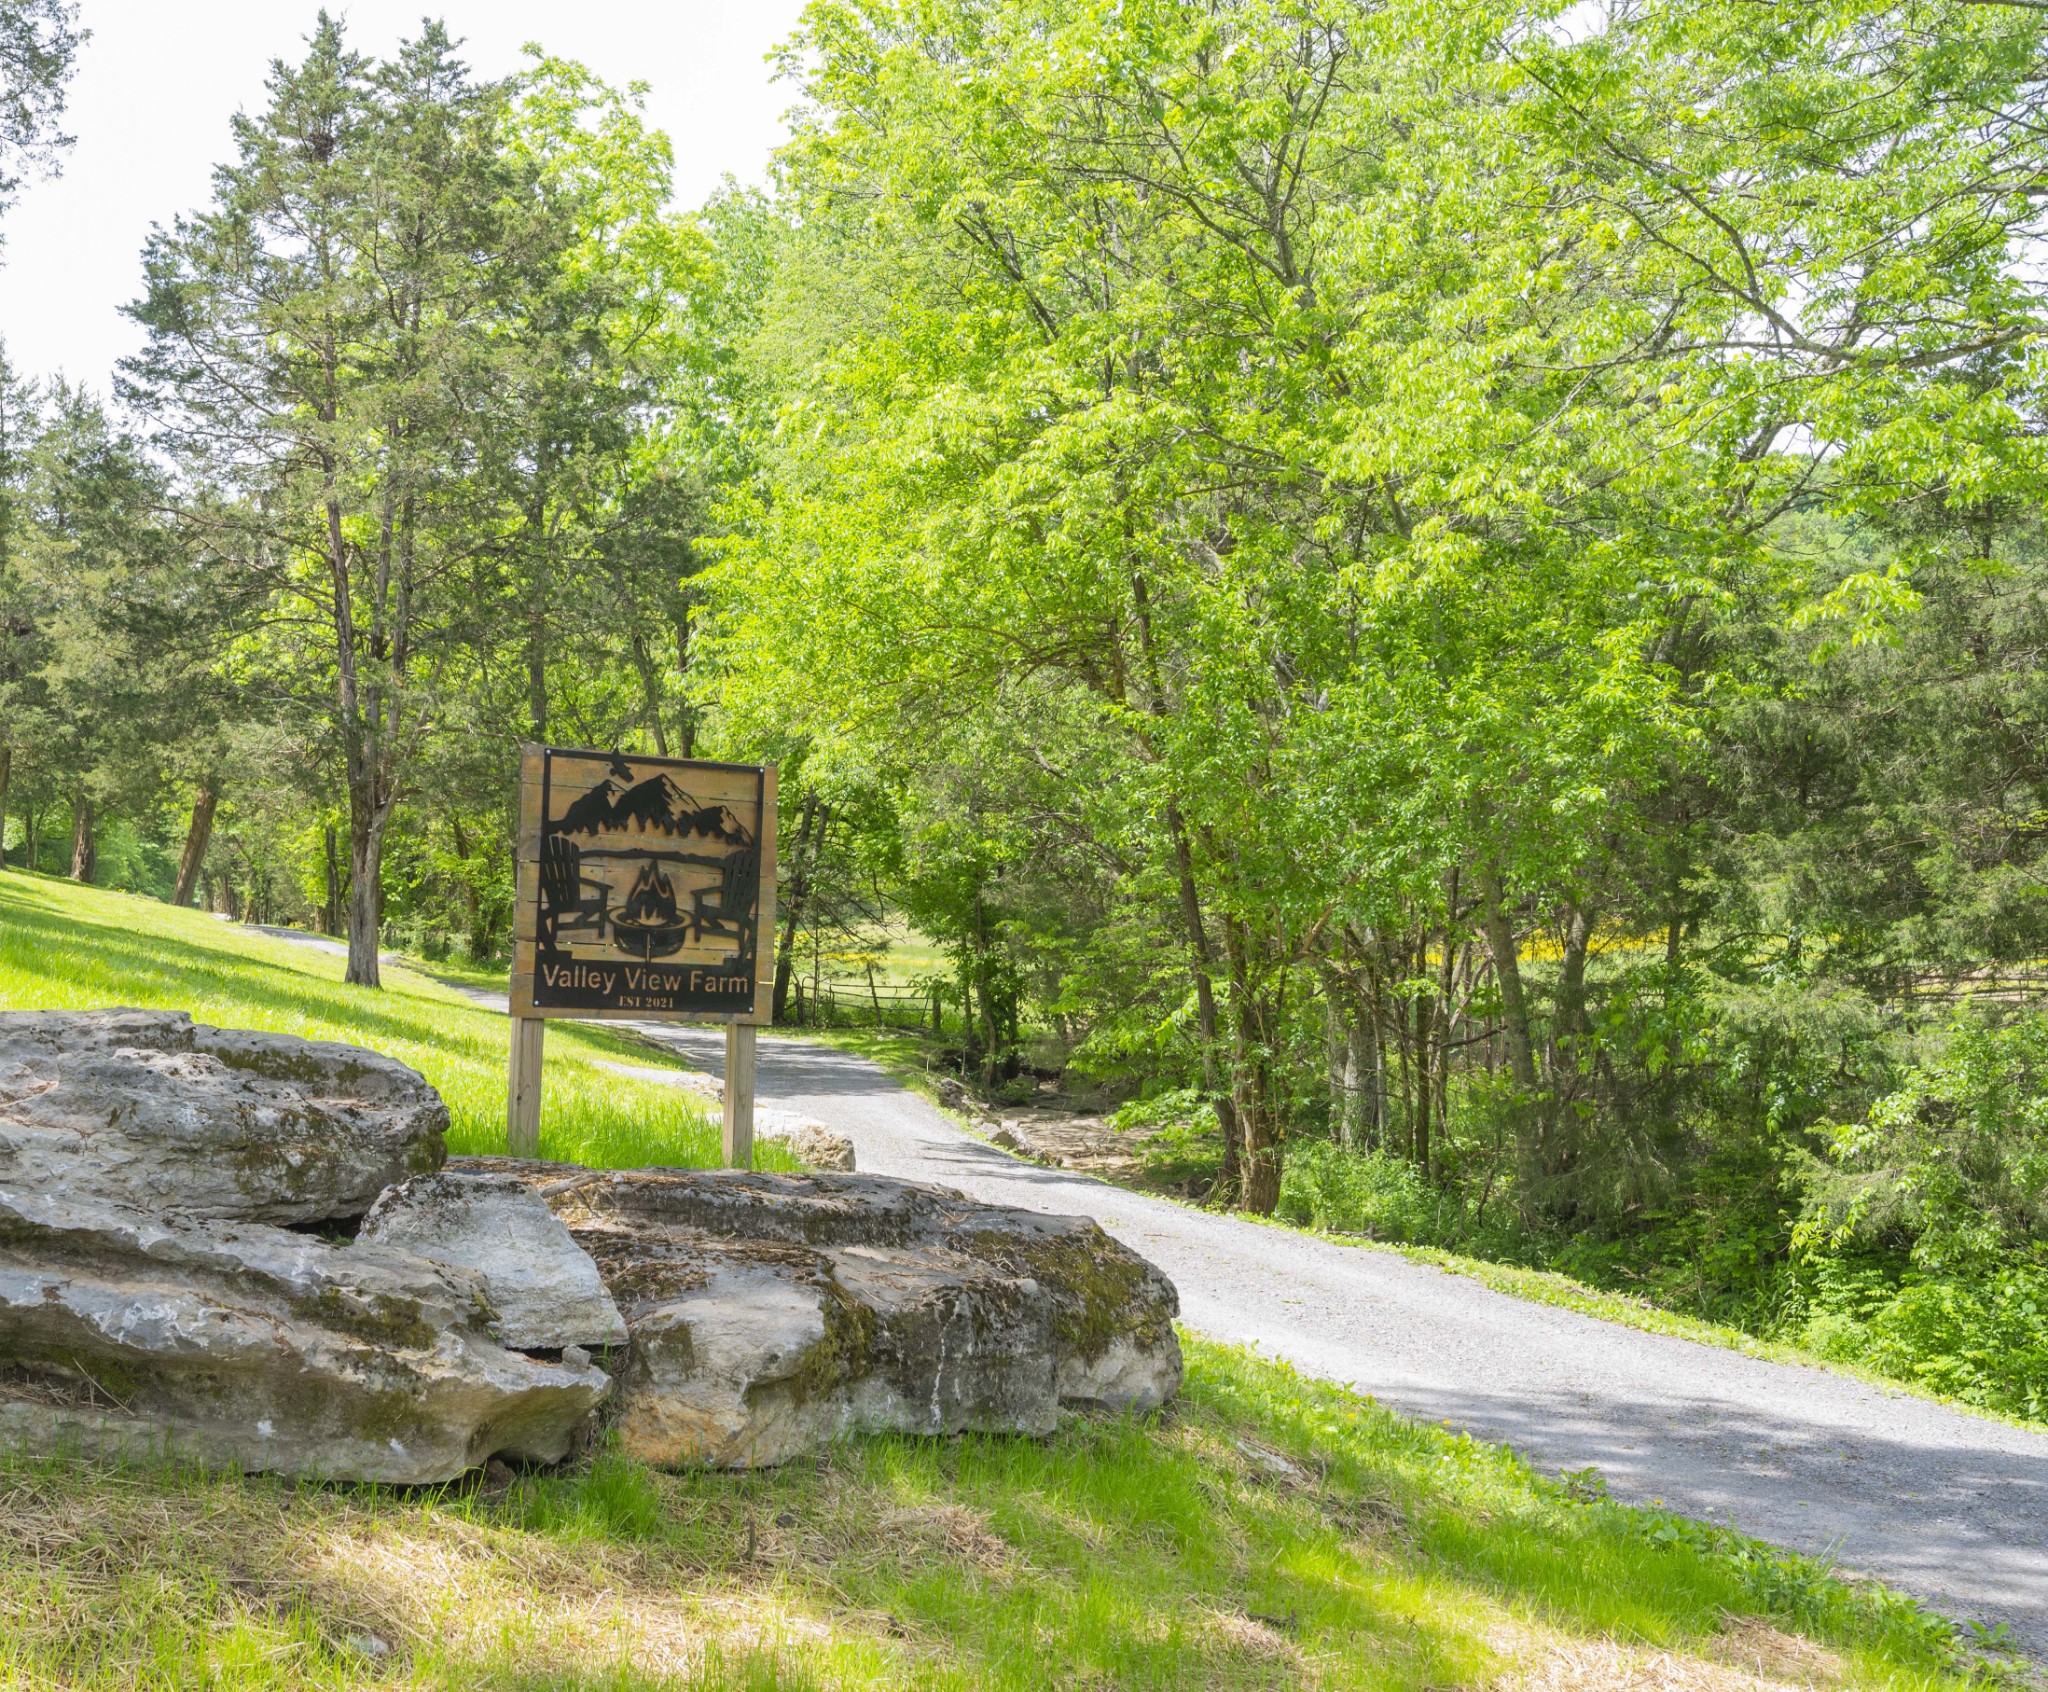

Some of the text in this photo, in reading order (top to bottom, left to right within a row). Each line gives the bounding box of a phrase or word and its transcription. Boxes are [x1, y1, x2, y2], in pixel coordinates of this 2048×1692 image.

[542, 963, 748, 994] Valley View Farm
[619, 995, 673, 1008] EST 2021
